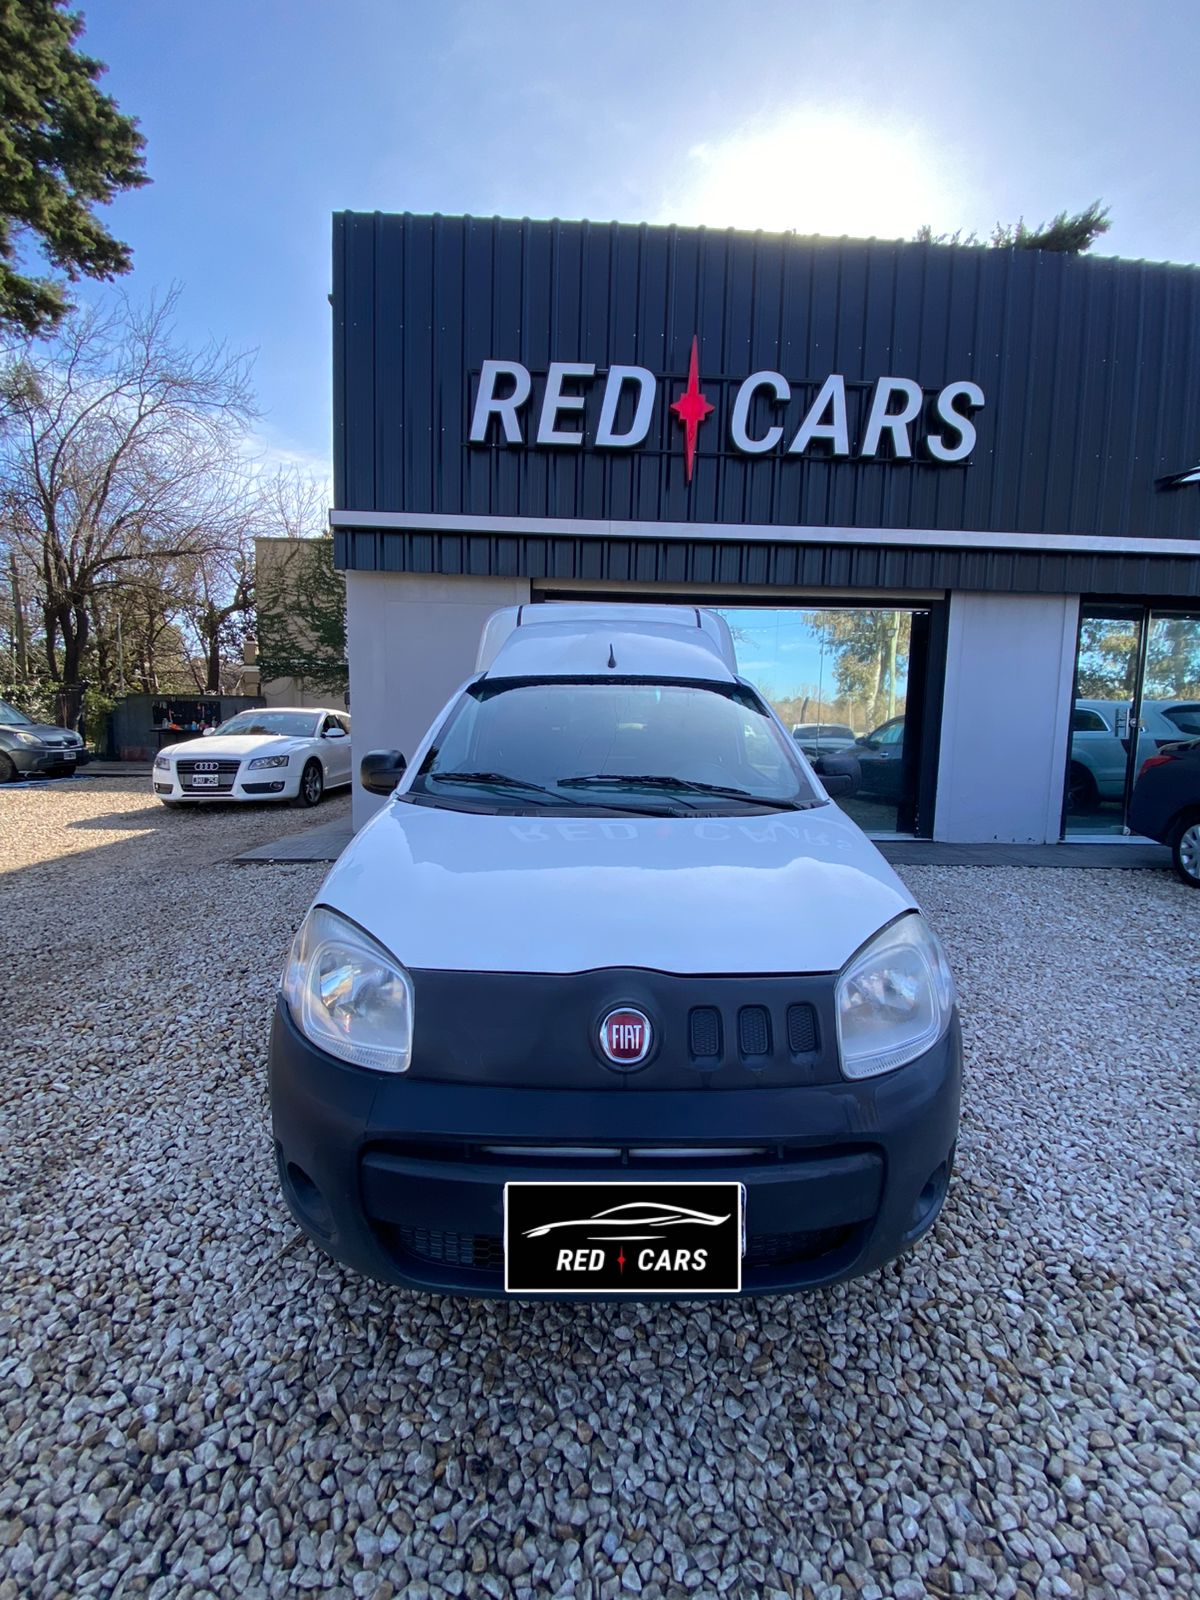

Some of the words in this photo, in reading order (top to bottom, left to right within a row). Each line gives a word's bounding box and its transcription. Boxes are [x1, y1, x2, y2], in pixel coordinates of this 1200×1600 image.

[468, 359, 657, 448] RED
[730, 370, 986, 463] CARS
[612, 1024, 642, 1050] FIAT
